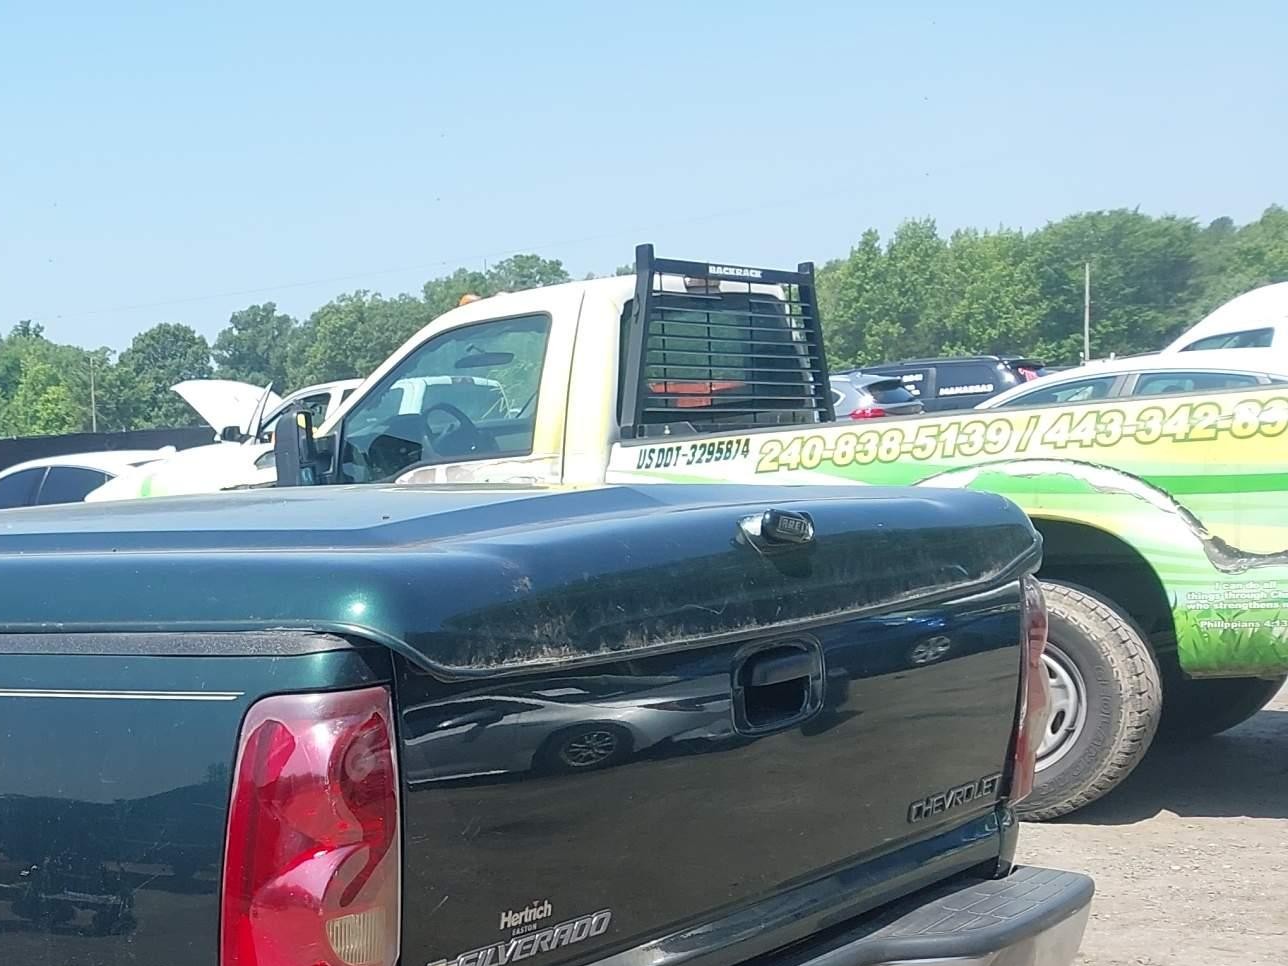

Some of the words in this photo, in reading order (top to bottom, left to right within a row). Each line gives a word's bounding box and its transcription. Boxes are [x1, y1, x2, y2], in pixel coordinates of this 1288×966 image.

[709, 265, 763, 278] BACKRACK
[755, 417, 1013, 473] 240-838-5139
[1245, 582, 1260, 590] do
[1263, 582, 1277, 590] all
[1187, 591, 1220, 601] things
[1223, 590, 1267, 601] through
[1187, 602, 1210, 610] who
[1212, 601, 1279, 610] strengthens
[1200, 620, 1260, 630] Philippians
[908, 772, 1003, 823] CHEVROLET
[500, 900, 552, 929] Hertrich
[512, 923, 538, 936] EASTON
